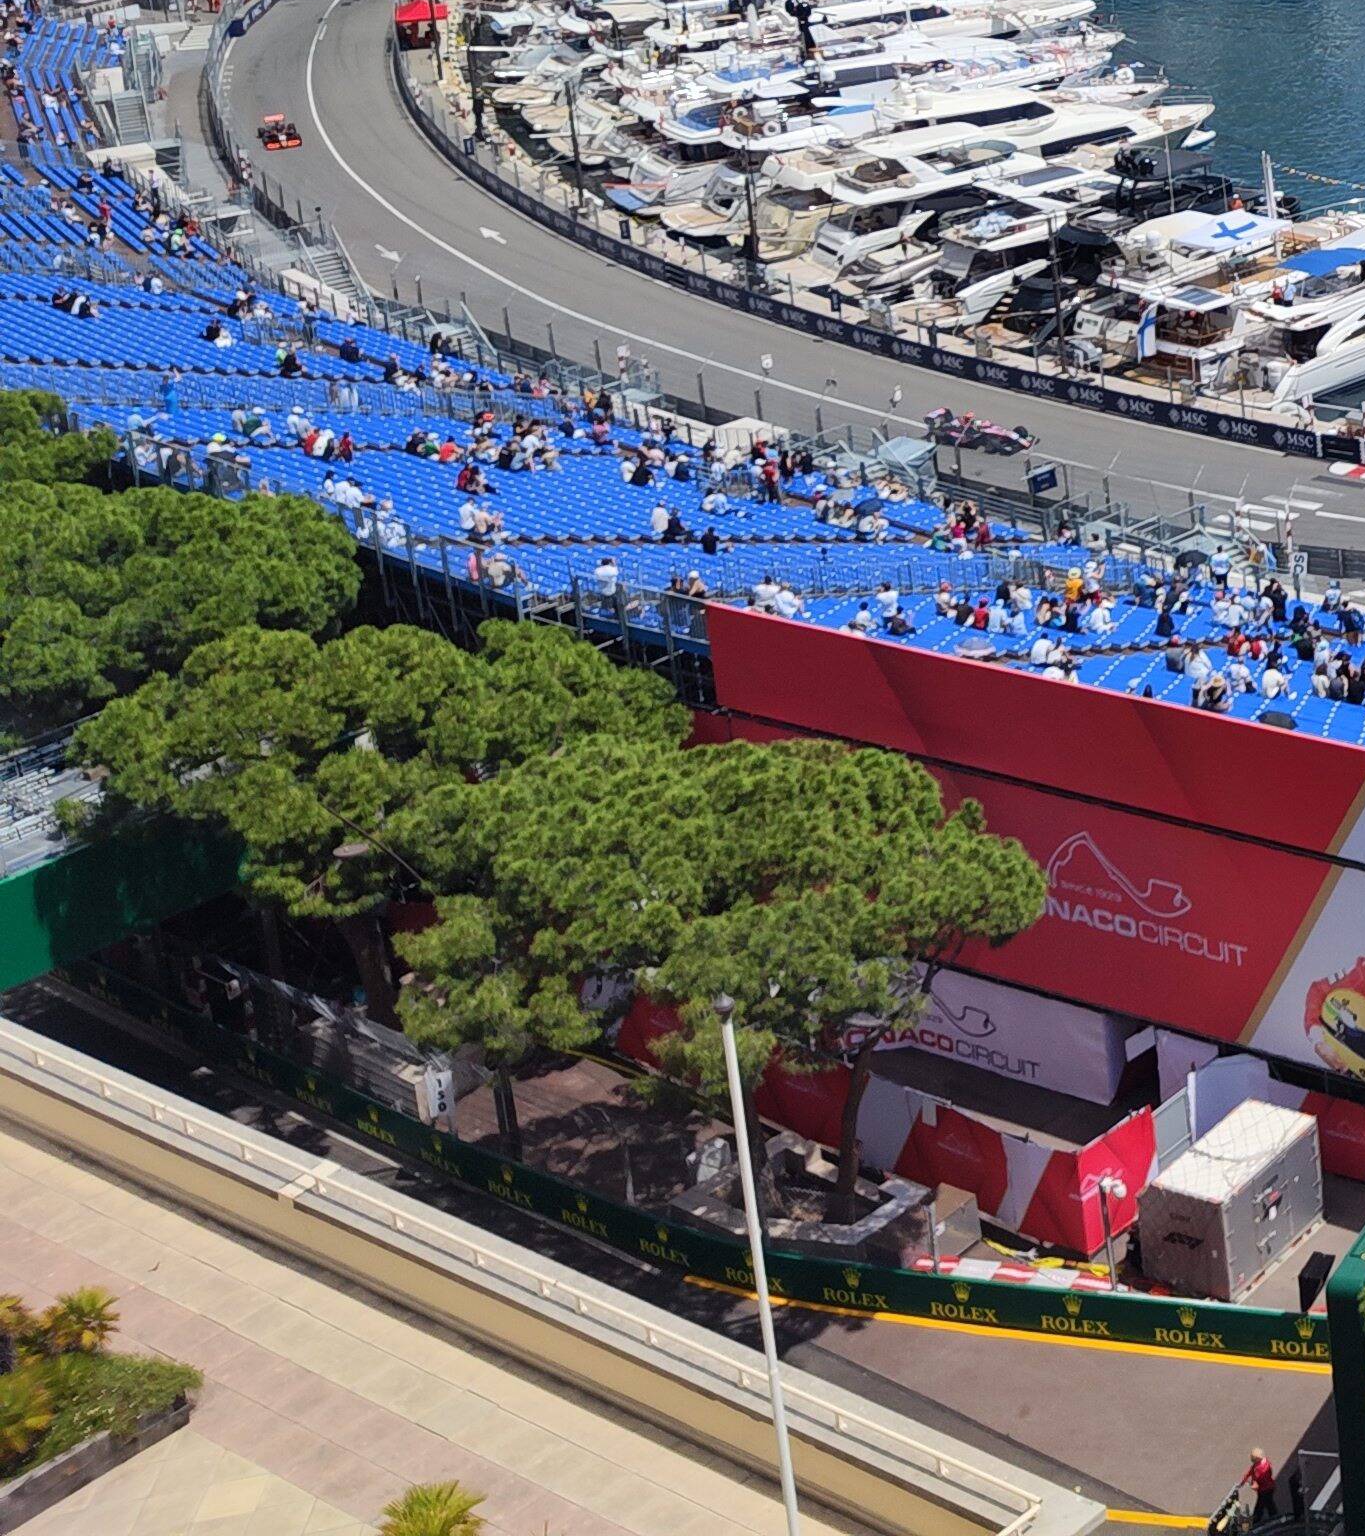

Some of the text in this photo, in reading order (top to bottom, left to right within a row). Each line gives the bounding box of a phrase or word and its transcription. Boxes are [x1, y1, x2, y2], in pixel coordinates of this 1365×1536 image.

[985, 365, 1009, 382] MSC
[1031, 375, 1055, 393] MSC
[1079, 387, 1103, 403] MSC
[1128, 398, 1154, 415] MSC
[1180, 408, 1208, 427] MSC
[1231, 420, 1258, 437] MSC
[1286, 431, 1315, 449] MSC
[1046, 895, 1248, 967] NACOCIRCUIT
[488, 1179, 533, 1208] ROLEX
[562, 1208, 609, 1238] ROLEX
[640, 1237, 689, 1267] ROLEX
[824, 1286, 889, 1310] ROLEX
[930, 1300, 997, 1325] ROLEX
[1041, 1314, 1111, 1336] ROLEX
[1155, 1327, 1225, 1350] ROLEX
[1271, 1338, 1329, 1359] ROLE
